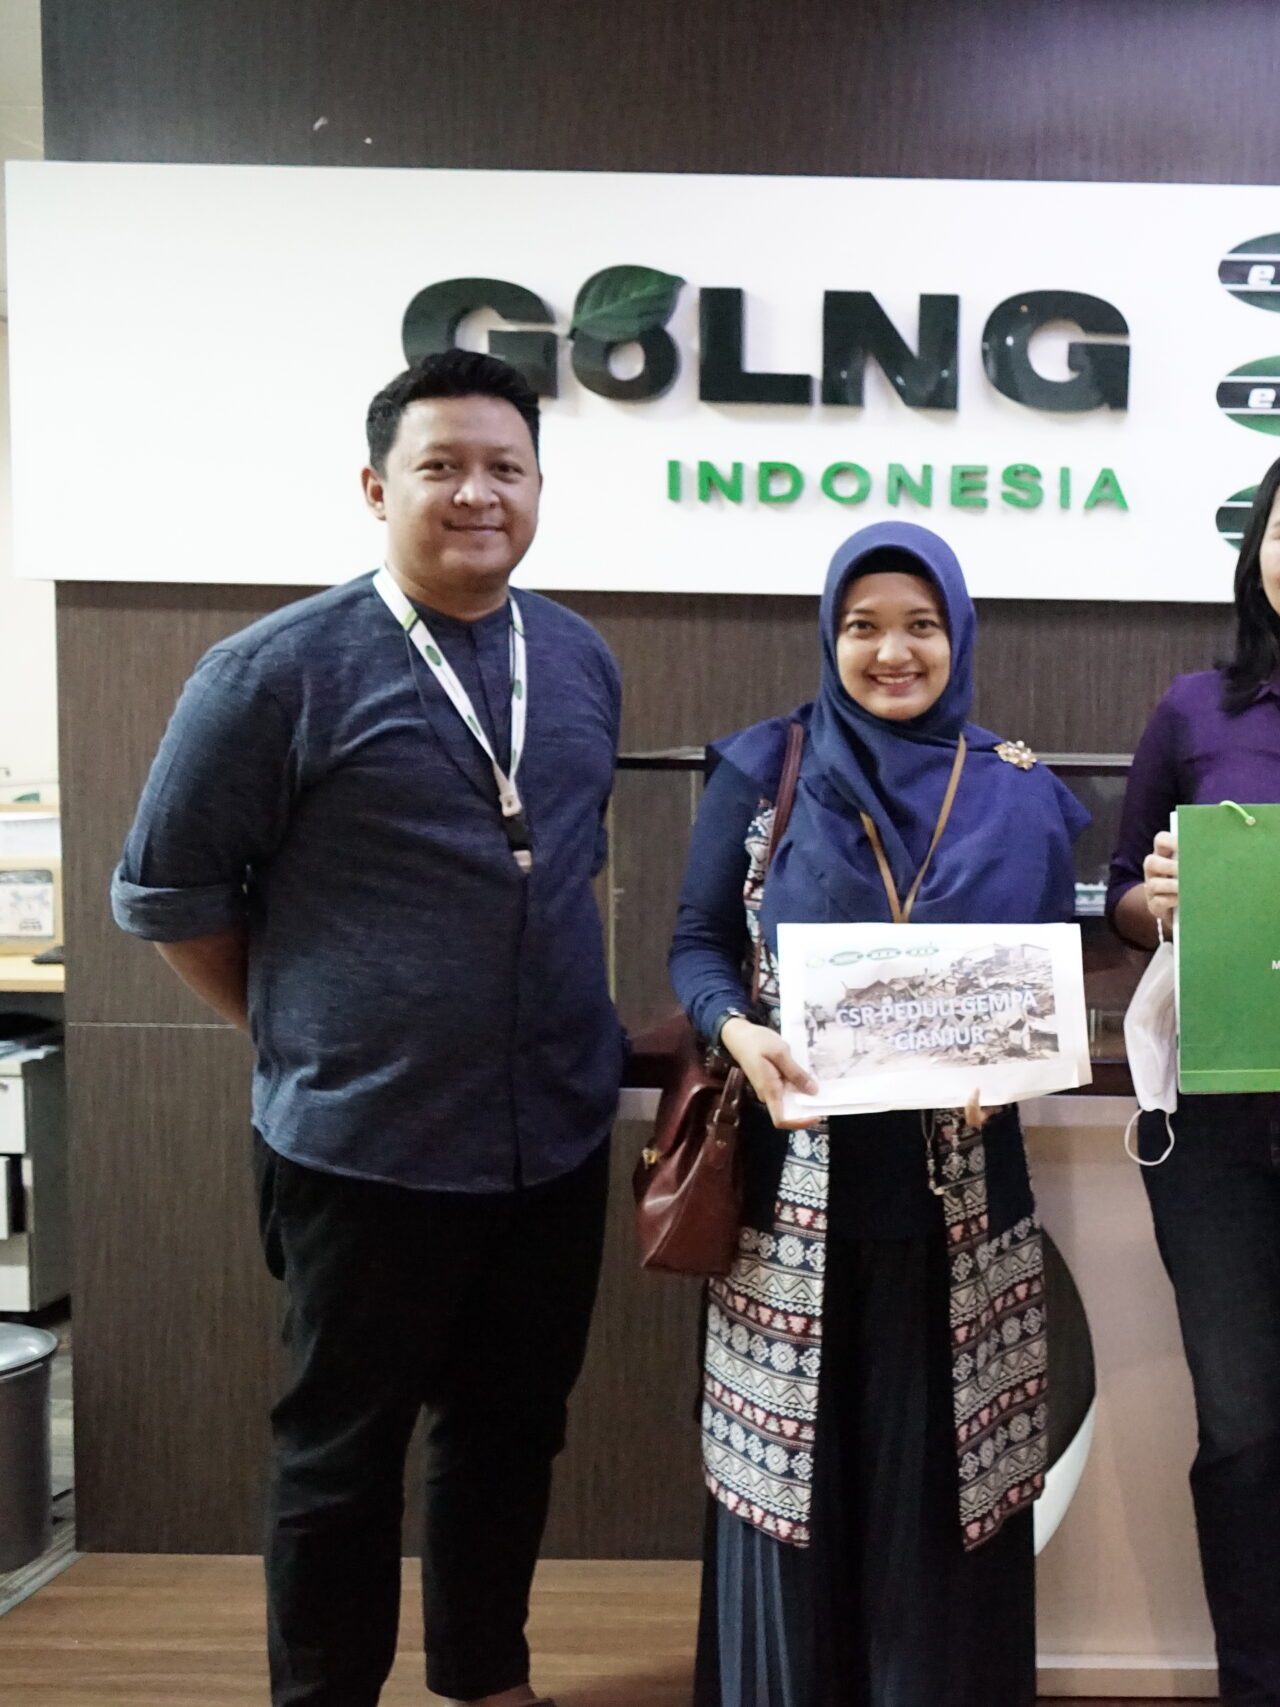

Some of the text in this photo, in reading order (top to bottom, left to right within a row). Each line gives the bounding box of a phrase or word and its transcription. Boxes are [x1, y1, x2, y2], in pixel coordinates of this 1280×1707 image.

[667, 460, 1129, 511] INDONESIA
[835, 990, 1037, 1027] CSR PEDULI GEMPA
[895, 1026, 984, 1050] CIANJUR
